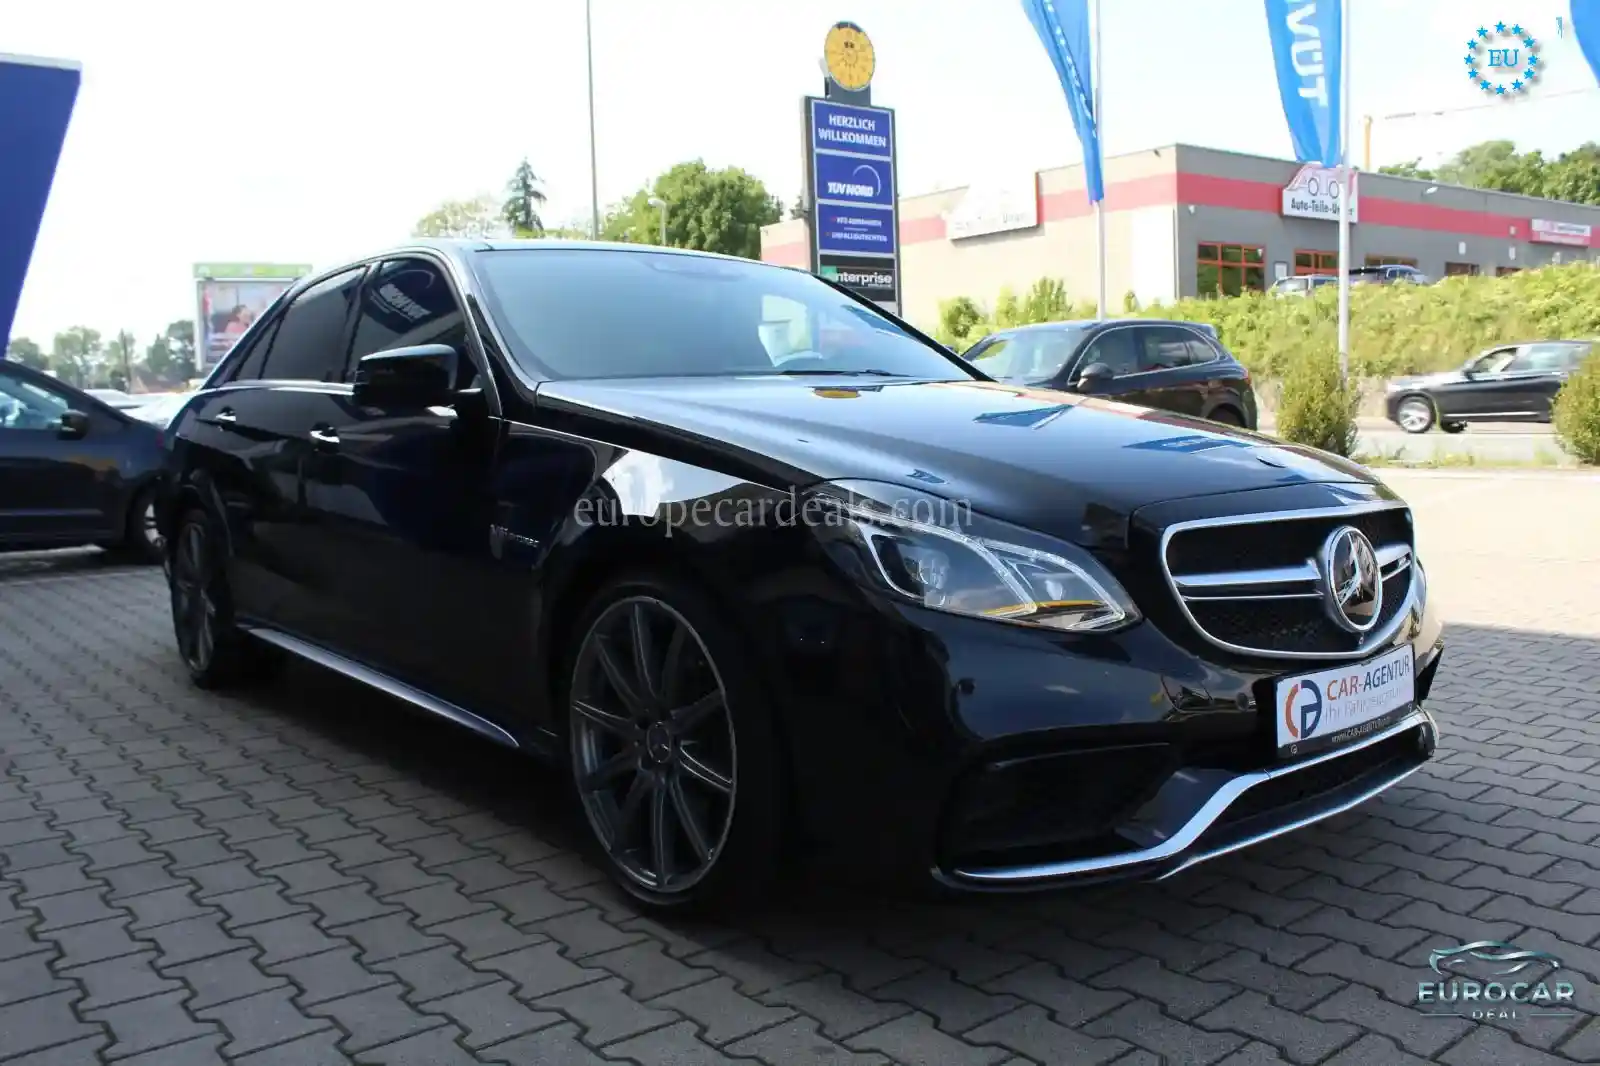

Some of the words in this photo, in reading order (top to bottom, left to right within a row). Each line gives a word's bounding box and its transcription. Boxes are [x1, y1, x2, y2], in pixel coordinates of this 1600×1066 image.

[829, 114, 876, 132] HERZLICH
[818, 128, 887, 148] WILLKOMMEN
[1327, 655, 1410, 701] CAR-AGENTUR
